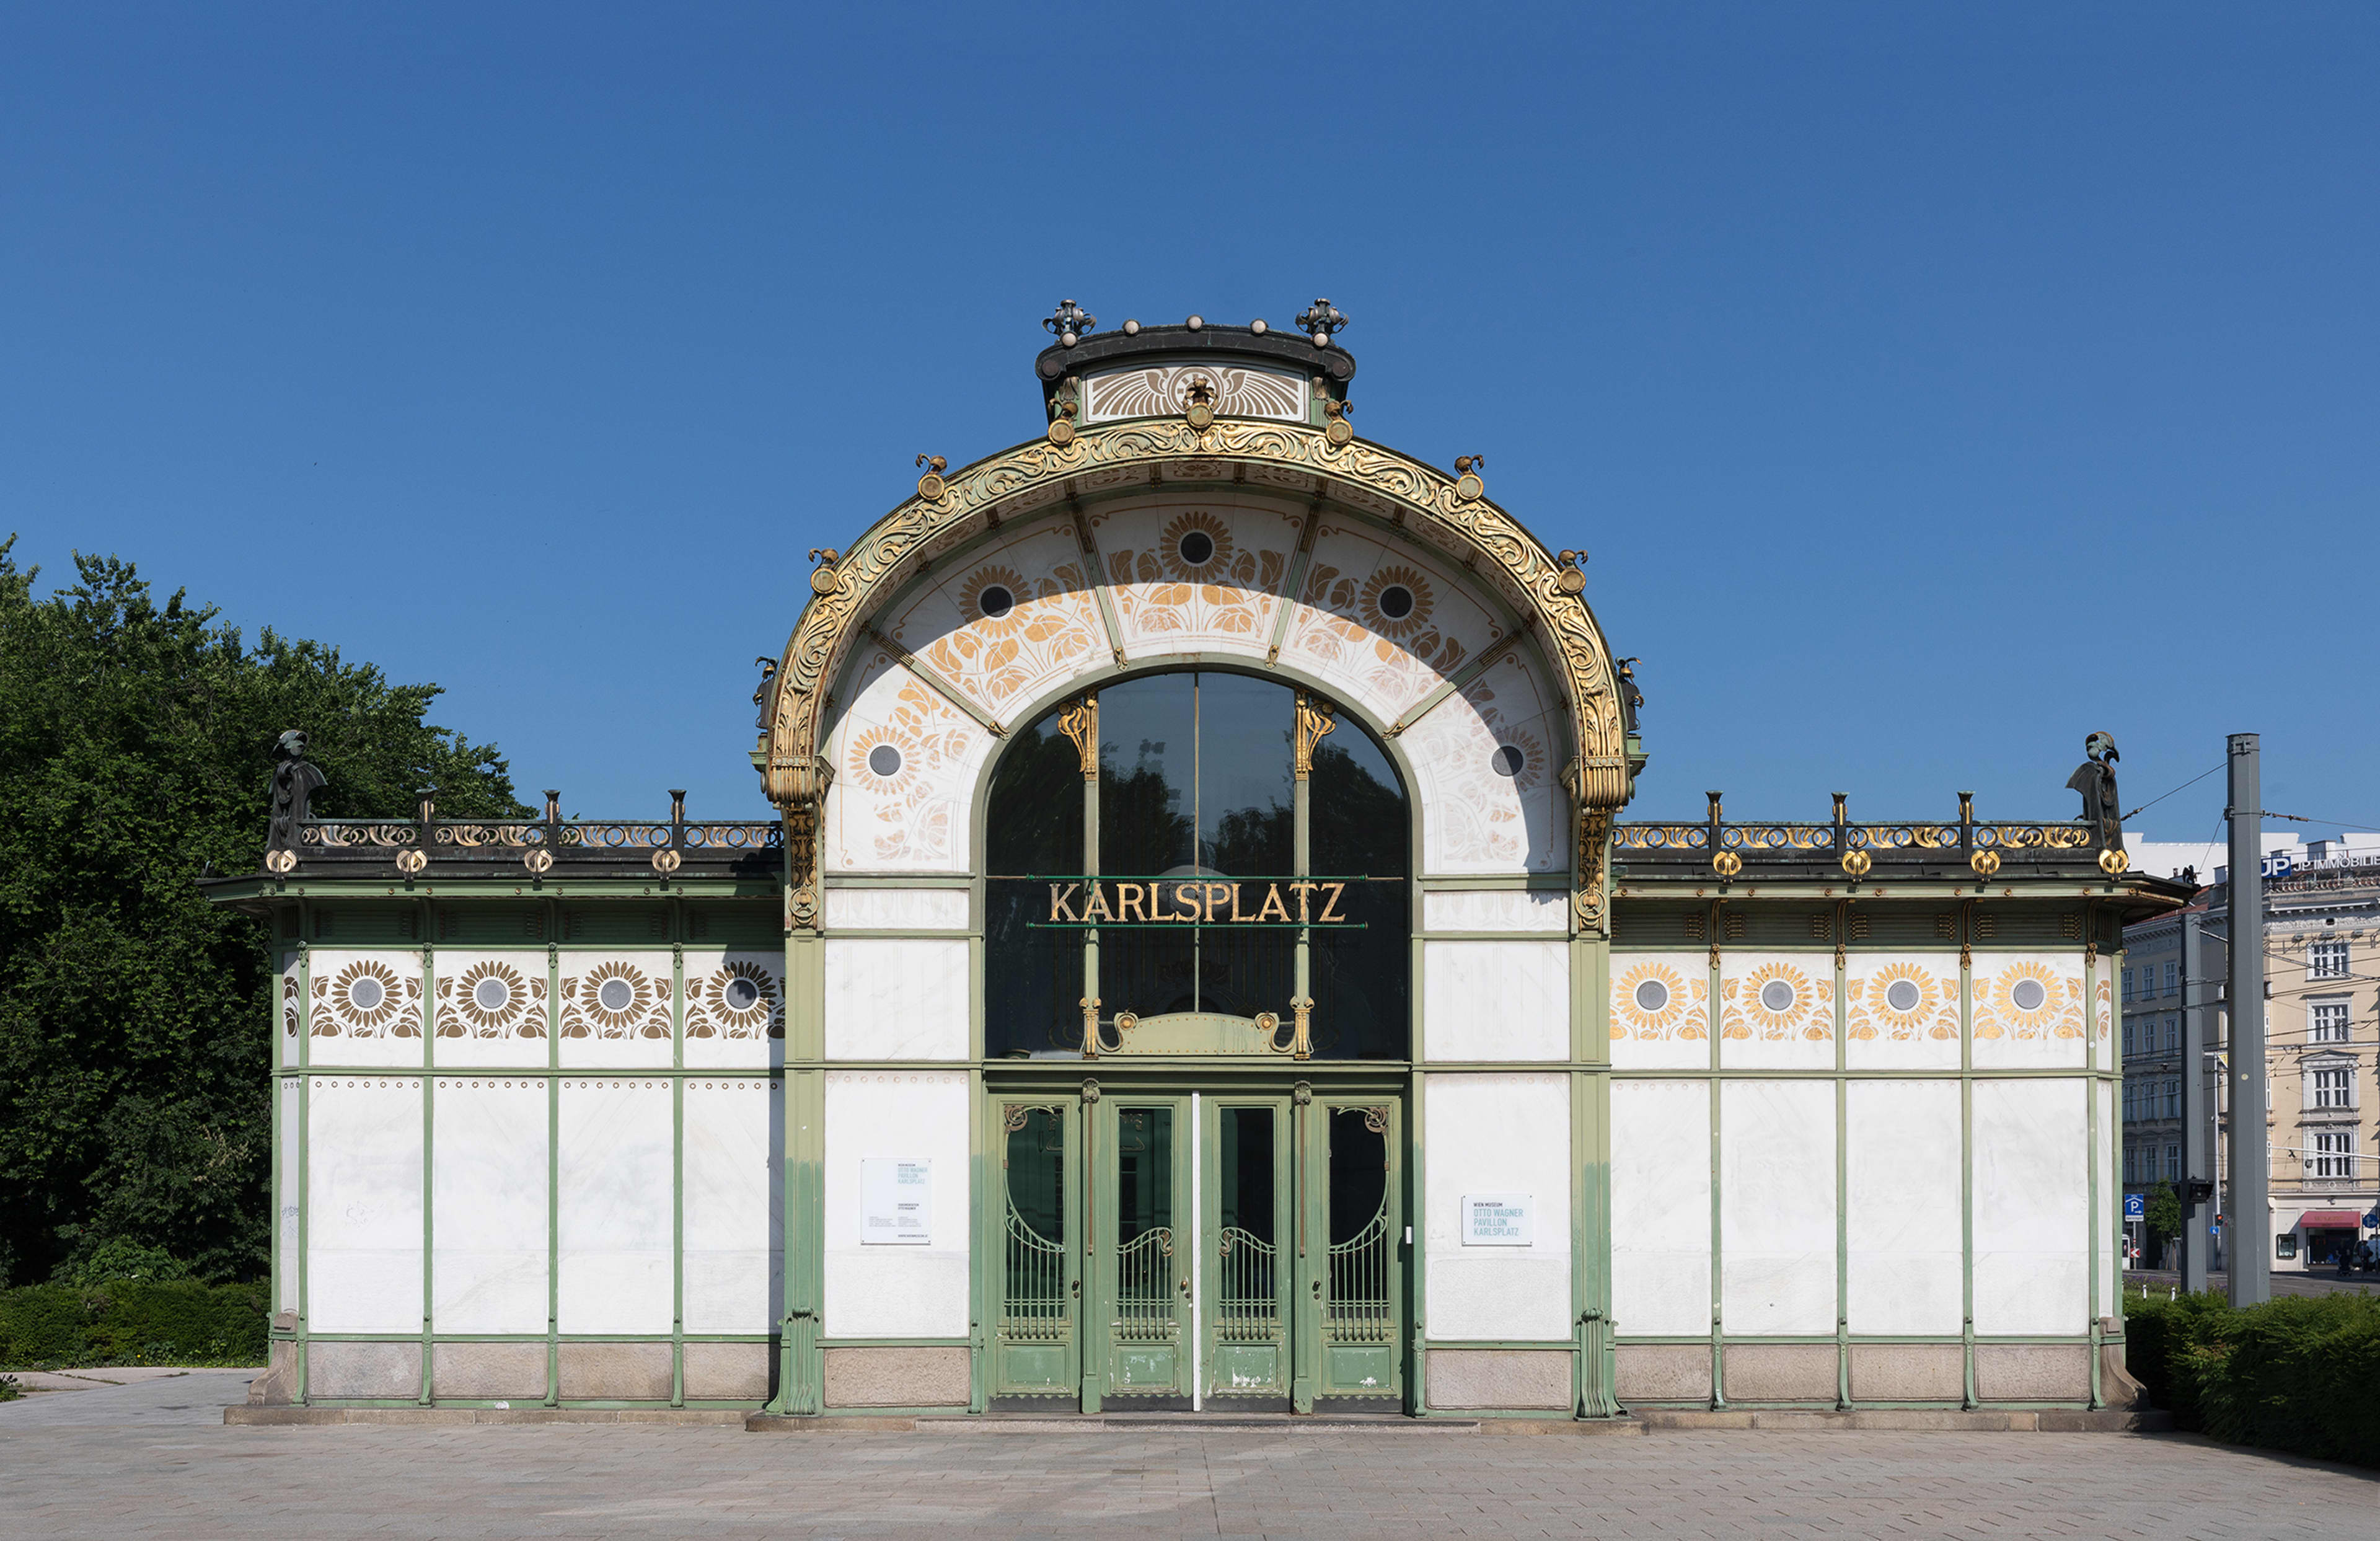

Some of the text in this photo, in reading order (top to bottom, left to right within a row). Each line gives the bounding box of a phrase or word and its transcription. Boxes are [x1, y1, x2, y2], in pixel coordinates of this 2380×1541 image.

[2261, 858, 2290, 876] JP
[2294, 860, 2311, 872] JP
[1049, 883, 1346, 922] KARLSPLATZ
[2131, 1201, 2139, 1212] P
[1473, 1208, 1523, 1217] OTTO WAGNER
[1473, 1218, 1507, 1226] PAVILLON
[1473, 1227, 1518, 1235] KARLSPLATZ
